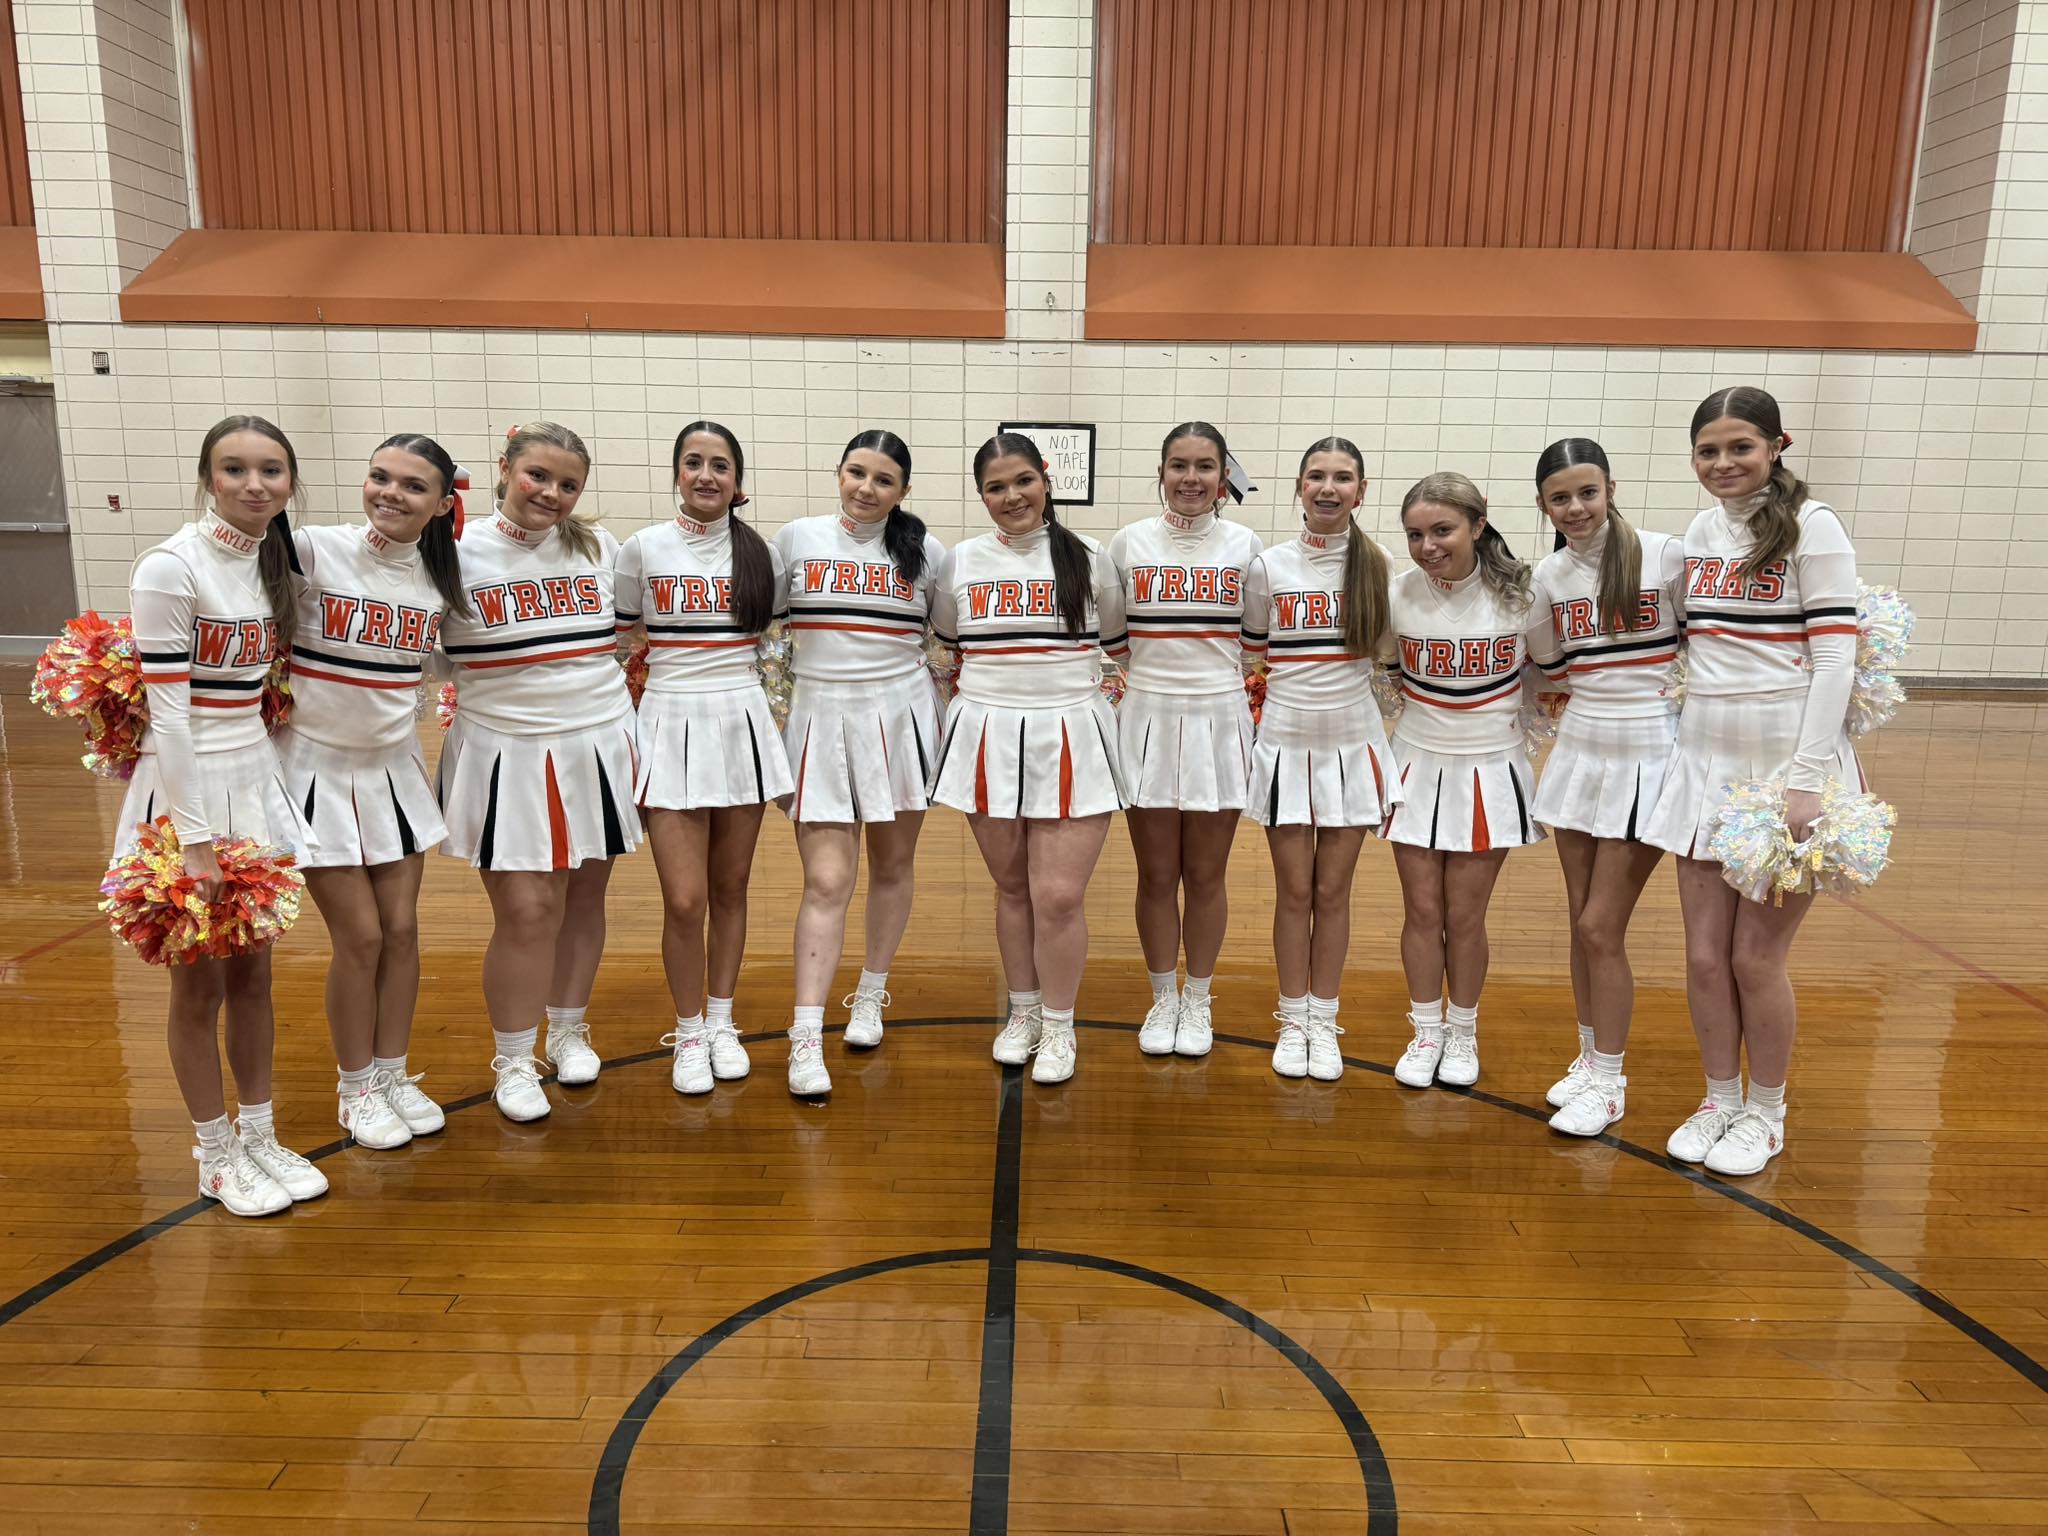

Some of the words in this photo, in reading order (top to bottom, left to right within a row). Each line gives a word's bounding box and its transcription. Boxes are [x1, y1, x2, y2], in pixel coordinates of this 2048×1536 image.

[1049, 435, 1080, 449] NOT
[1056, 452, 1087, 470] TAPE
[364, 528, 390, 551] KAIT
[495, 519, 527, 541] MEGAN
[648, 575, 733, 614] WRH
[804, 559, 914, 601] WRHS
[1132, 566, 1240, 604] WRHS
[472, 576, 602, 628] WRHS
[968, 580, 1056, 620] WRH
[192, 615, 277, 668] WRH
[1399, 633, 1518, 678] WRHS
